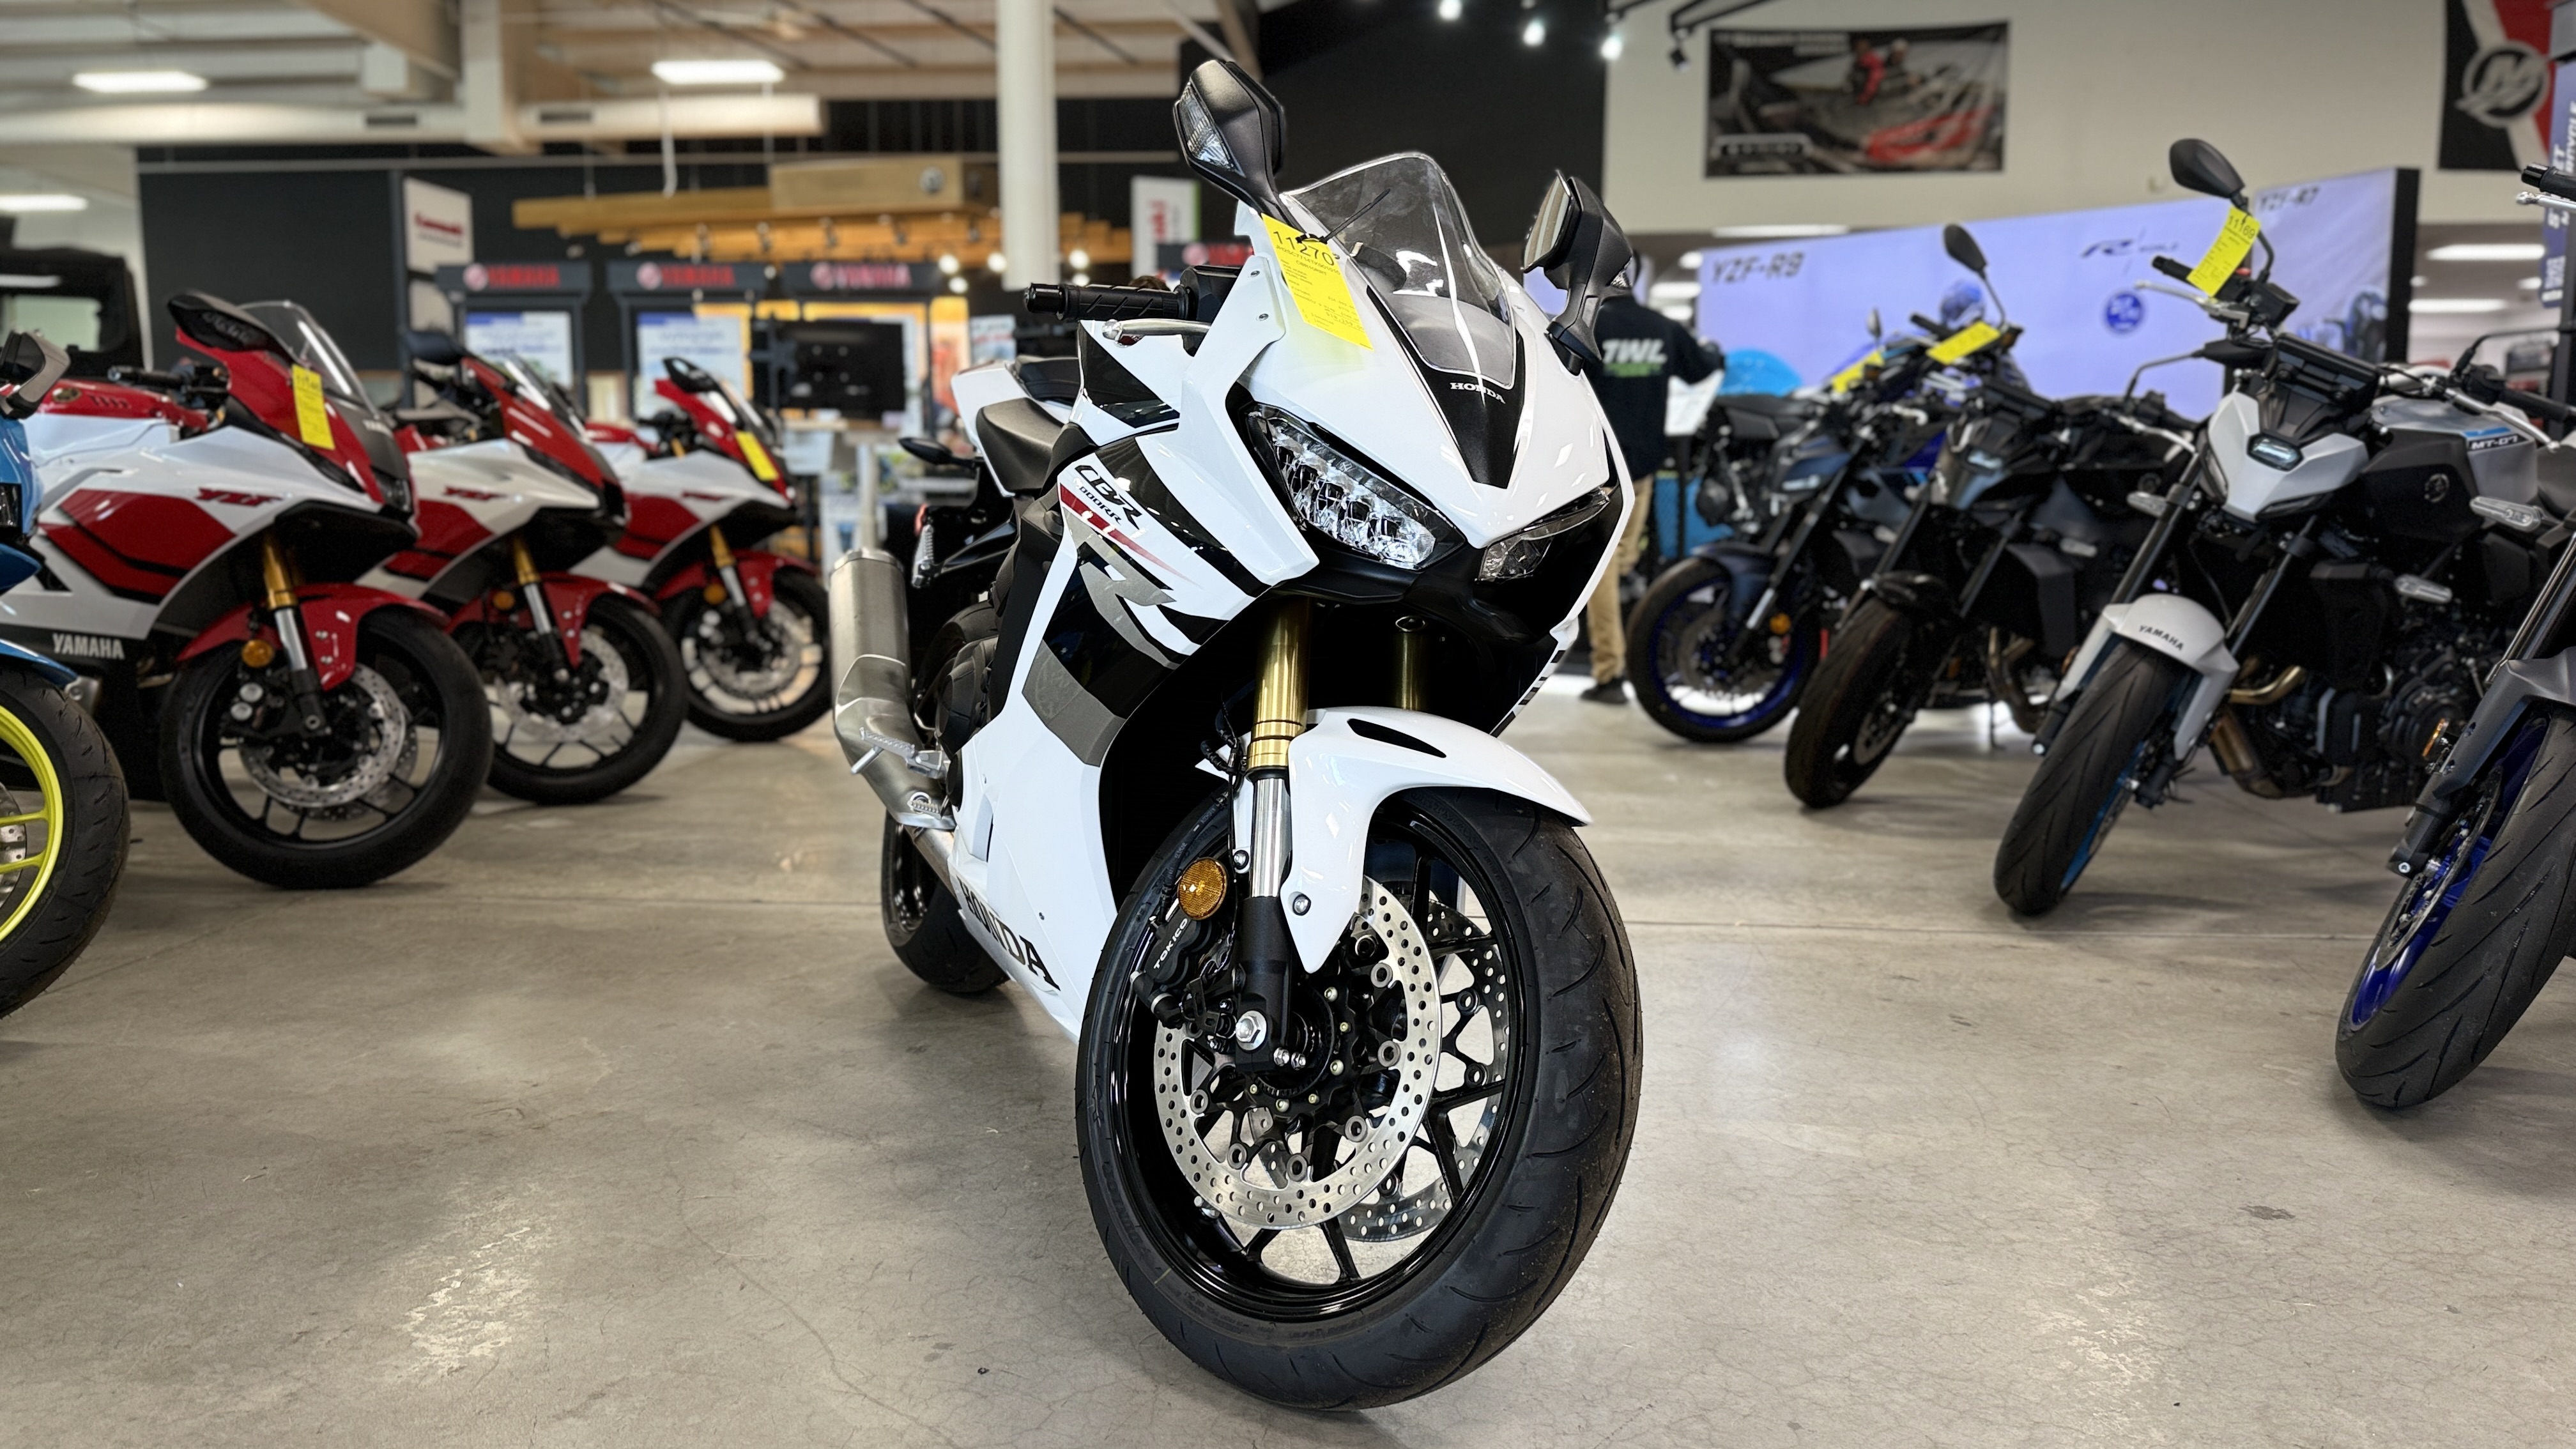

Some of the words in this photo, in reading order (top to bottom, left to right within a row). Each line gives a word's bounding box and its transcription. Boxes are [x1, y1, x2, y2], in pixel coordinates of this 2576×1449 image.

[2228, 215, 2256, 240] 11169
[1273, 231, 1335, 266] 11270
[1712, 252, 1805, 282] YZF-R9
[1602, 338, 1667, 364] TWL
[1450, 382, 1506, 404] HONDA
[2471, 435, 2518, 450] MT-07
[1074, 478, 1122, 526] 000RR
[1075, 465, 1142, 530] CBR
[52, 632, 125, 660] YAMAHA
[2138, 625, 2184, 651] YAMAHA
[956, 875, 1061, 991] HONDA
[1154, 918, 1187, 970] TOKICO
